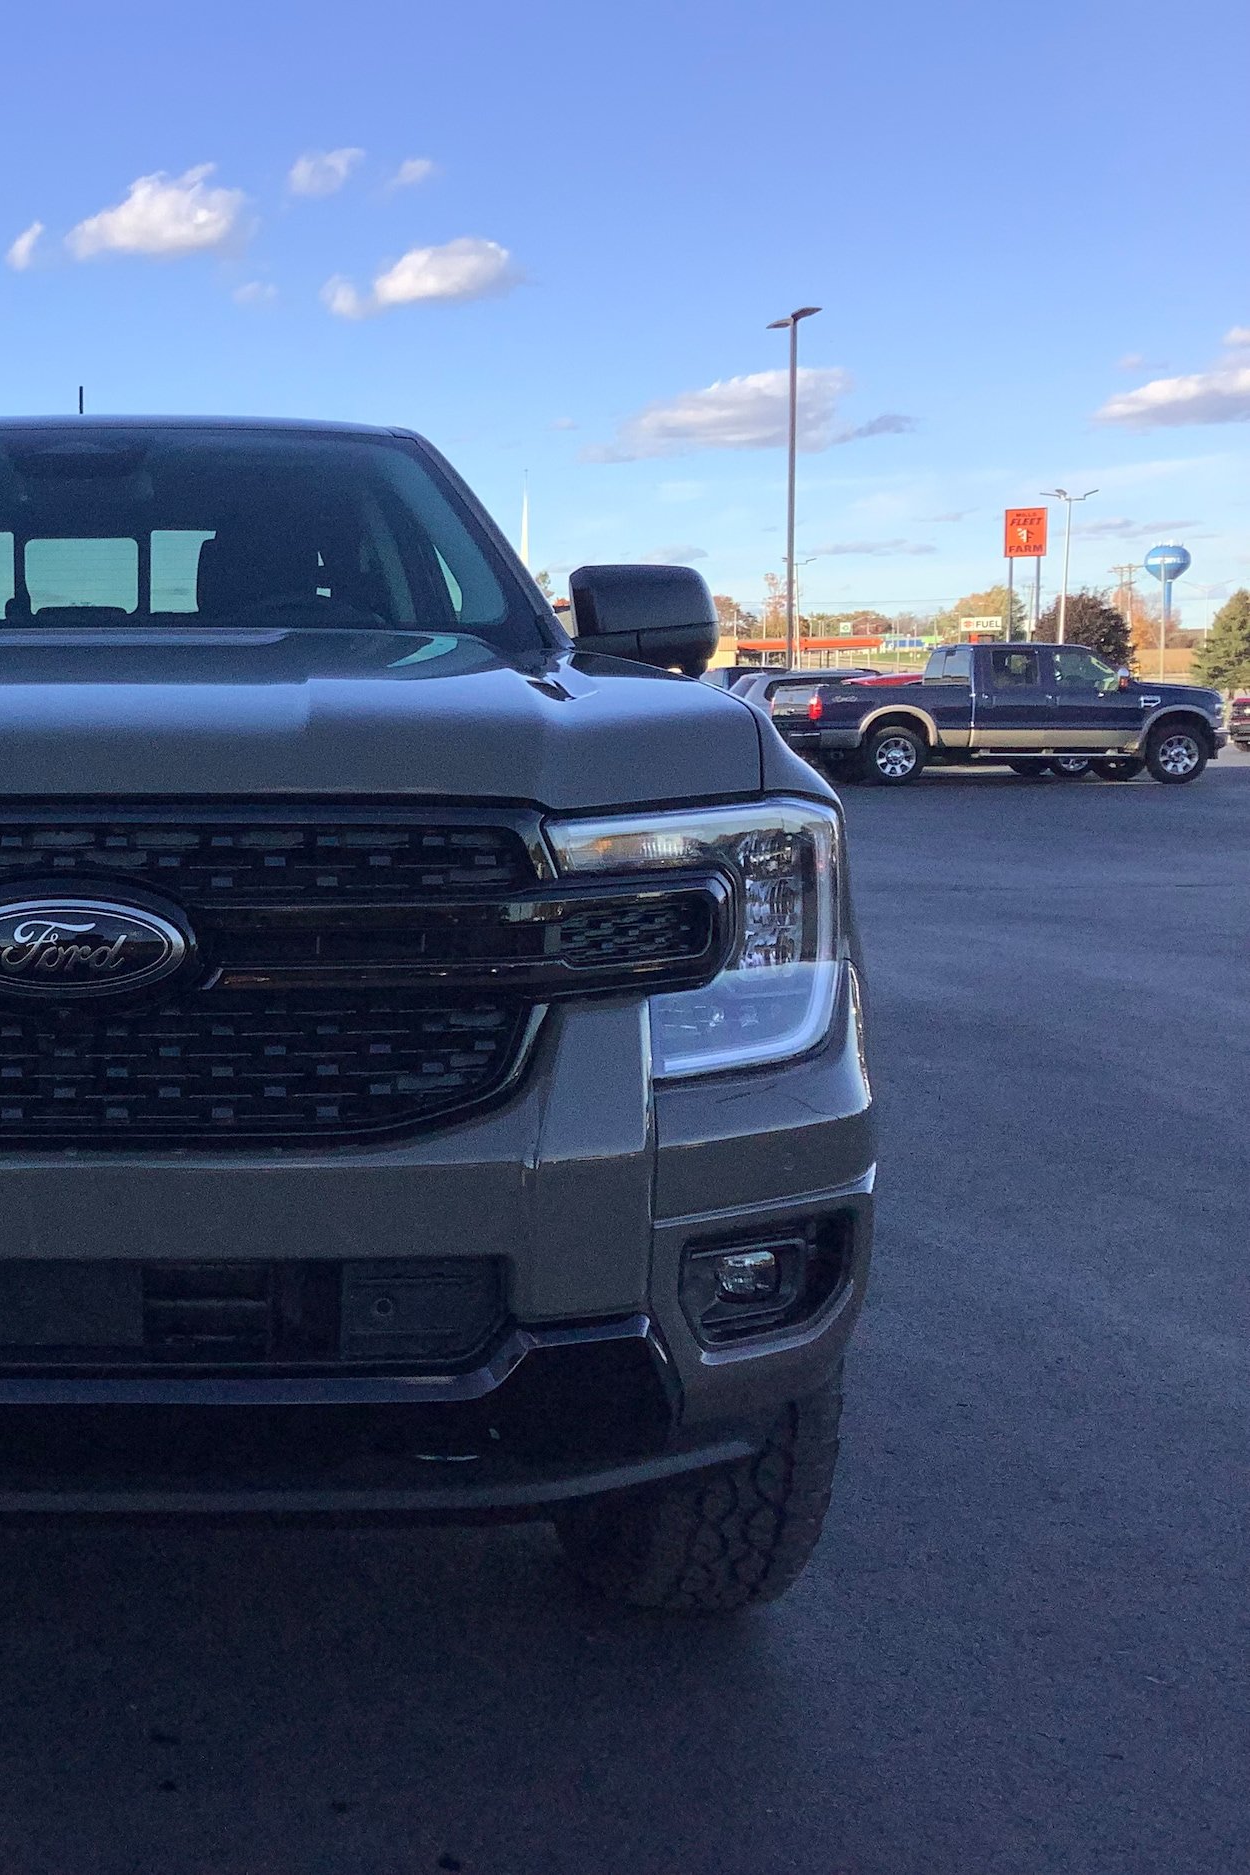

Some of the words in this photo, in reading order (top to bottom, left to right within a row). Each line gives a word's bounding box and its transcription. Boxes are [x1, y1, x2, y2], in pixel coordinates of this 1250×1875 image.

[1010, 517, 1044, 526] FLEET
[1009, 544, 1043, 553] FARM
[976, 620, 1001, 628] FUEL
[1, 920, 128, 972] Ford
